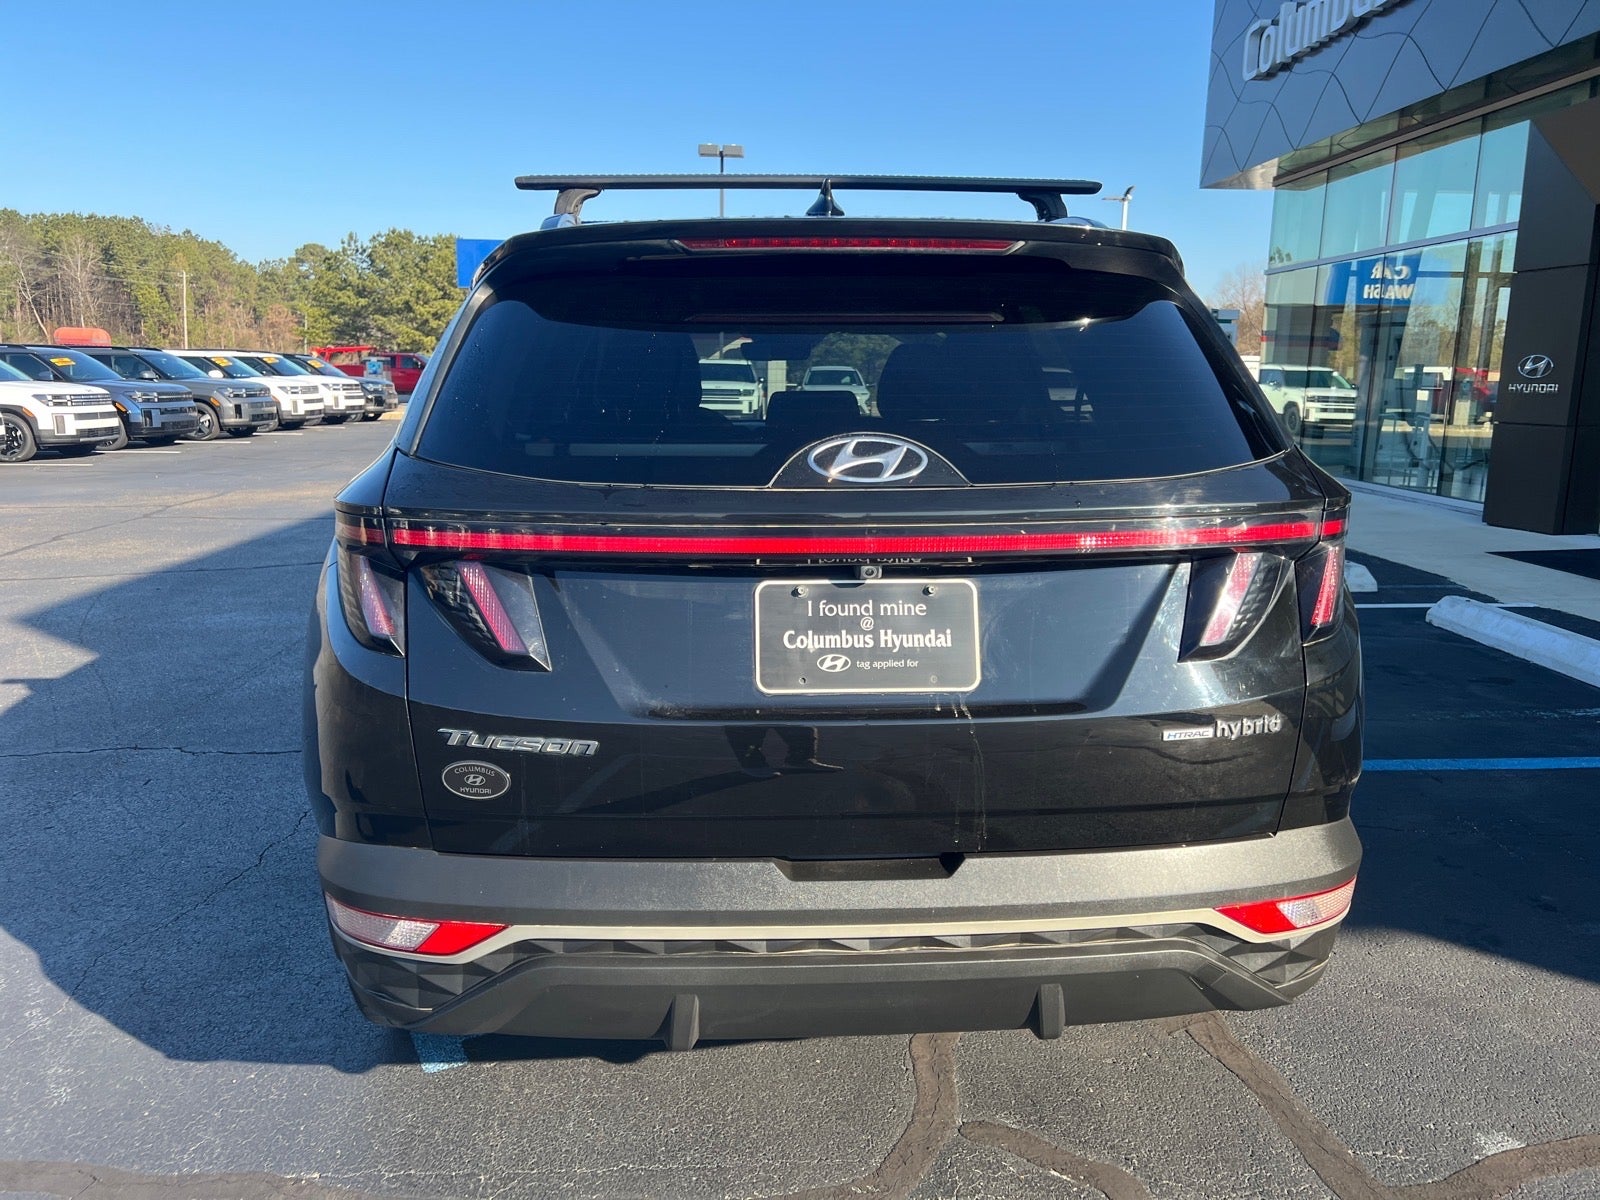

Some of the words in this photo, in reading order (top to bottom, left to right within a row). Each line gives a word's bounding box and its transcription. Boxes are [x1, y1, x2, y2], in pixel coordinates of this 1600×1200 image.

[1242, 0, 1390, 81] Columb
[1508, 383, 1559, 393] HYUNDAI
[807, 600, 813, 617] I
[819, 600, 873, 617] found
[880, 600, 927, 616] mine
[860, 616, 875, 631] @
[783, 630, 874, 649] Columbus
[879, 629, 952, 652] Hyundai
[856, 659, 871, 670] tag
[872, 659, 905, 669] applied
[906, 659, 919, 668] for
[1166, 729, 1210, 740] HTRAC
[1215, 714, 1281, 740] hybrid
[454, 766, 496, 777] COLUMBUS
[460, 787, 492, 795] HYUNDAI
